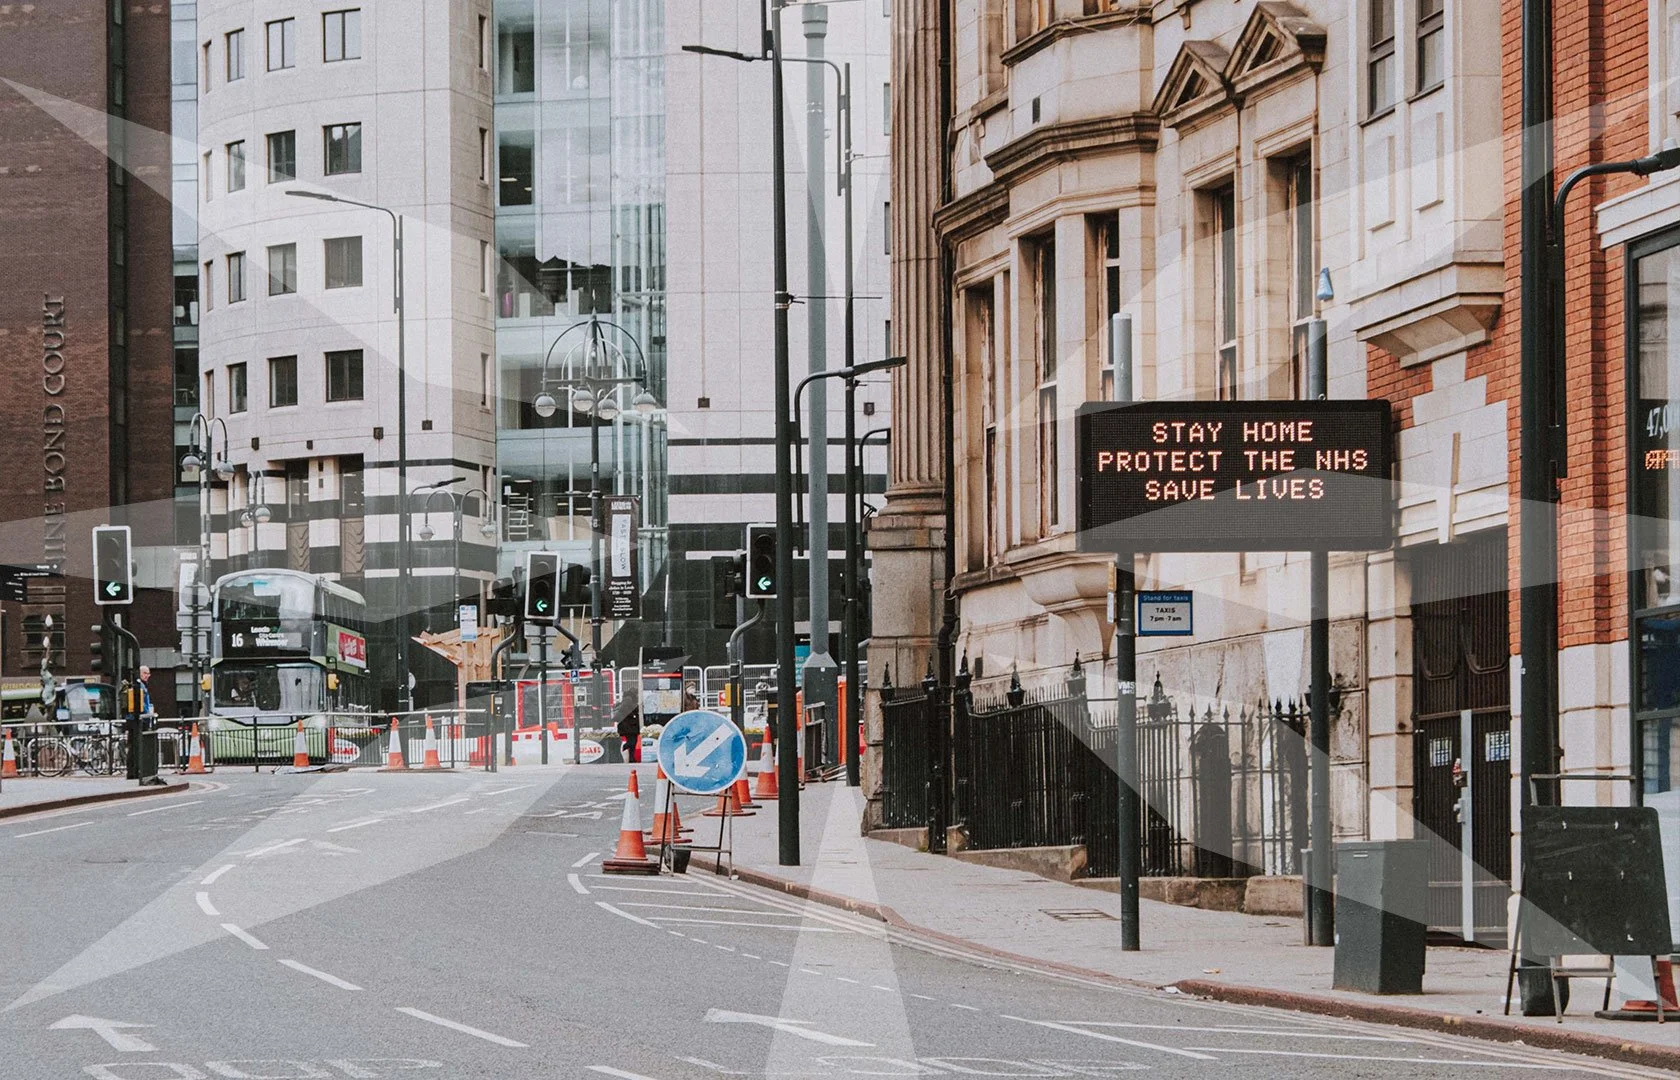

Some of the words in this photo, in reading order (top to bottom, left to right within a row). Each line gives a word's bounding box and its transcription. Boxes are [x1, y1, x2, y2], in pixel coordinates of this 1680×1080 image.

[43, 292, 65, 395] COURT
[1152, 421, 1223, 443] STAY
[1243, 421, 1313, 443] HOME
[44, 404, 65, 492] BOND
[1098, 451, 1223, 472] PROTECT
[1244, 450, 1296, 472] THE
[1316, 449, 1369, 471] NHS
[1145, 480, 1216, 501] SAVE
[1236, 479, 1325, 500] LIVES
[231, 633, 244, 647] 16
